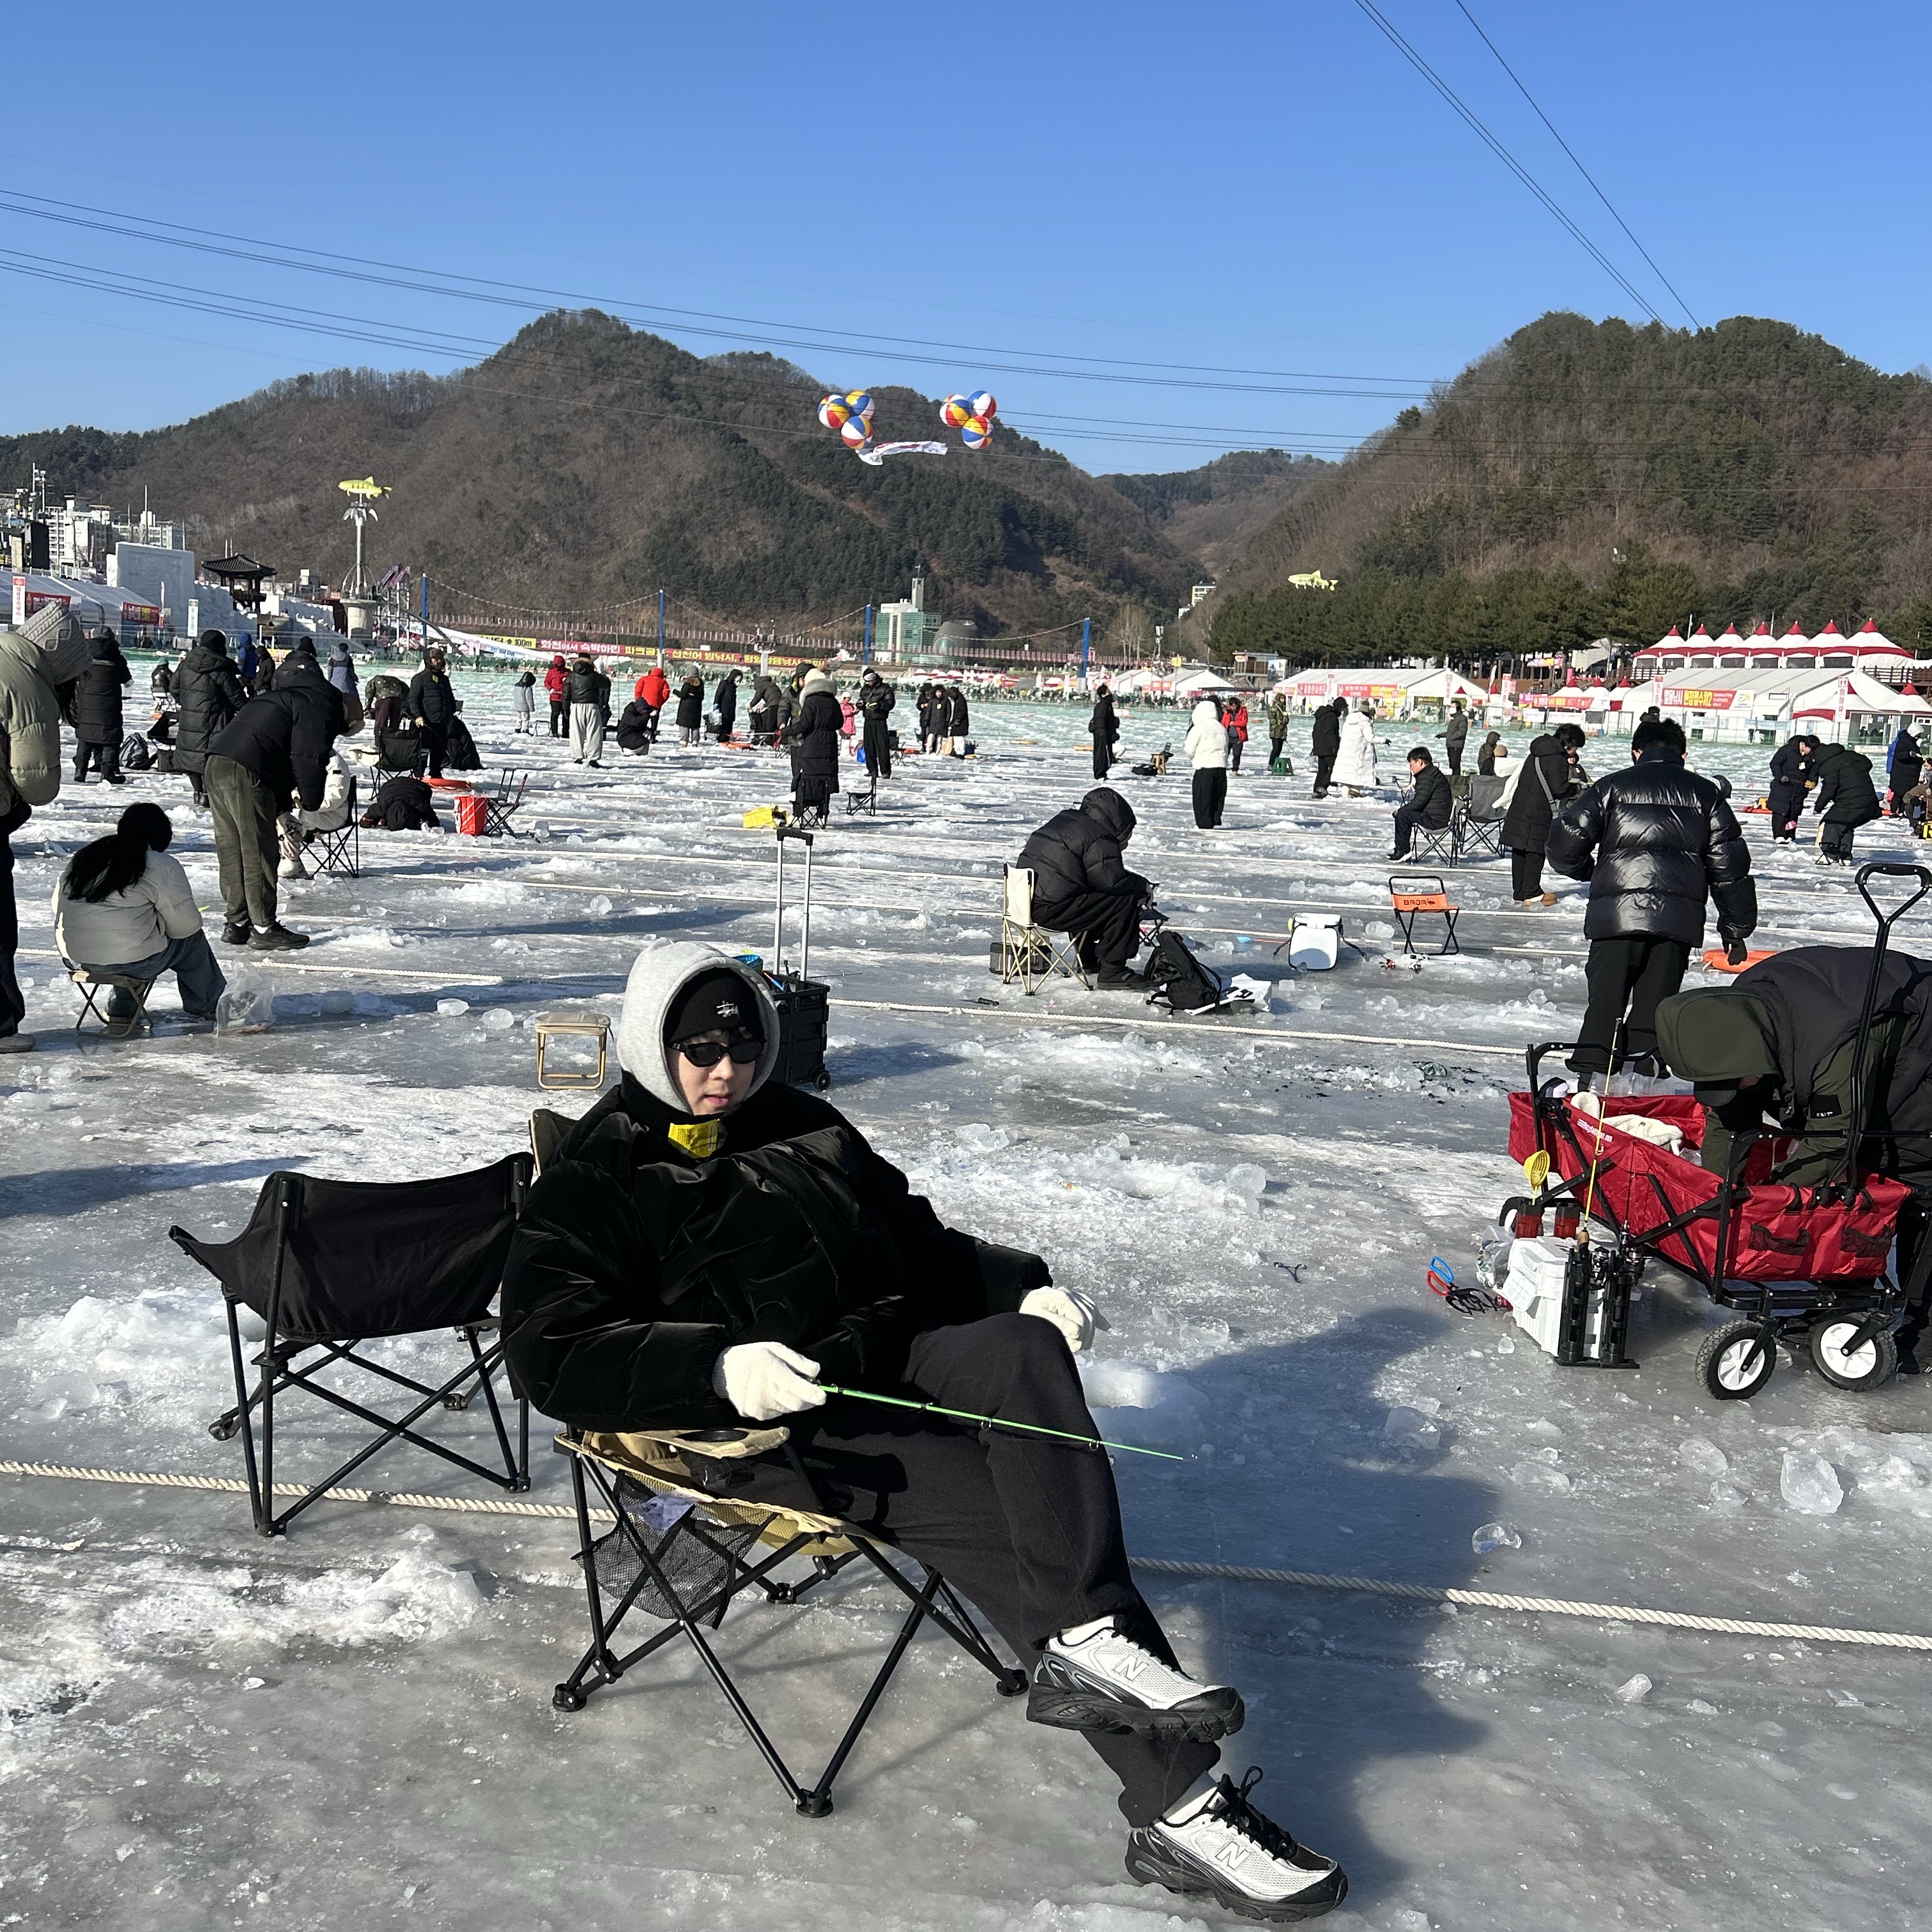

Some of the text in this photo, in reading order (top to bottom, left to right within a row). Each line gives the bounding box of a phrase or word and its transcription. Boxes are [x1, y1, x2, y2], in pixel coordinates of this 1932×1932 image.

[673, 649, 702, 660] 산천어
[1112, 1654, 1149, 1681] N
[1215, 1840, 1252, 1870] N
